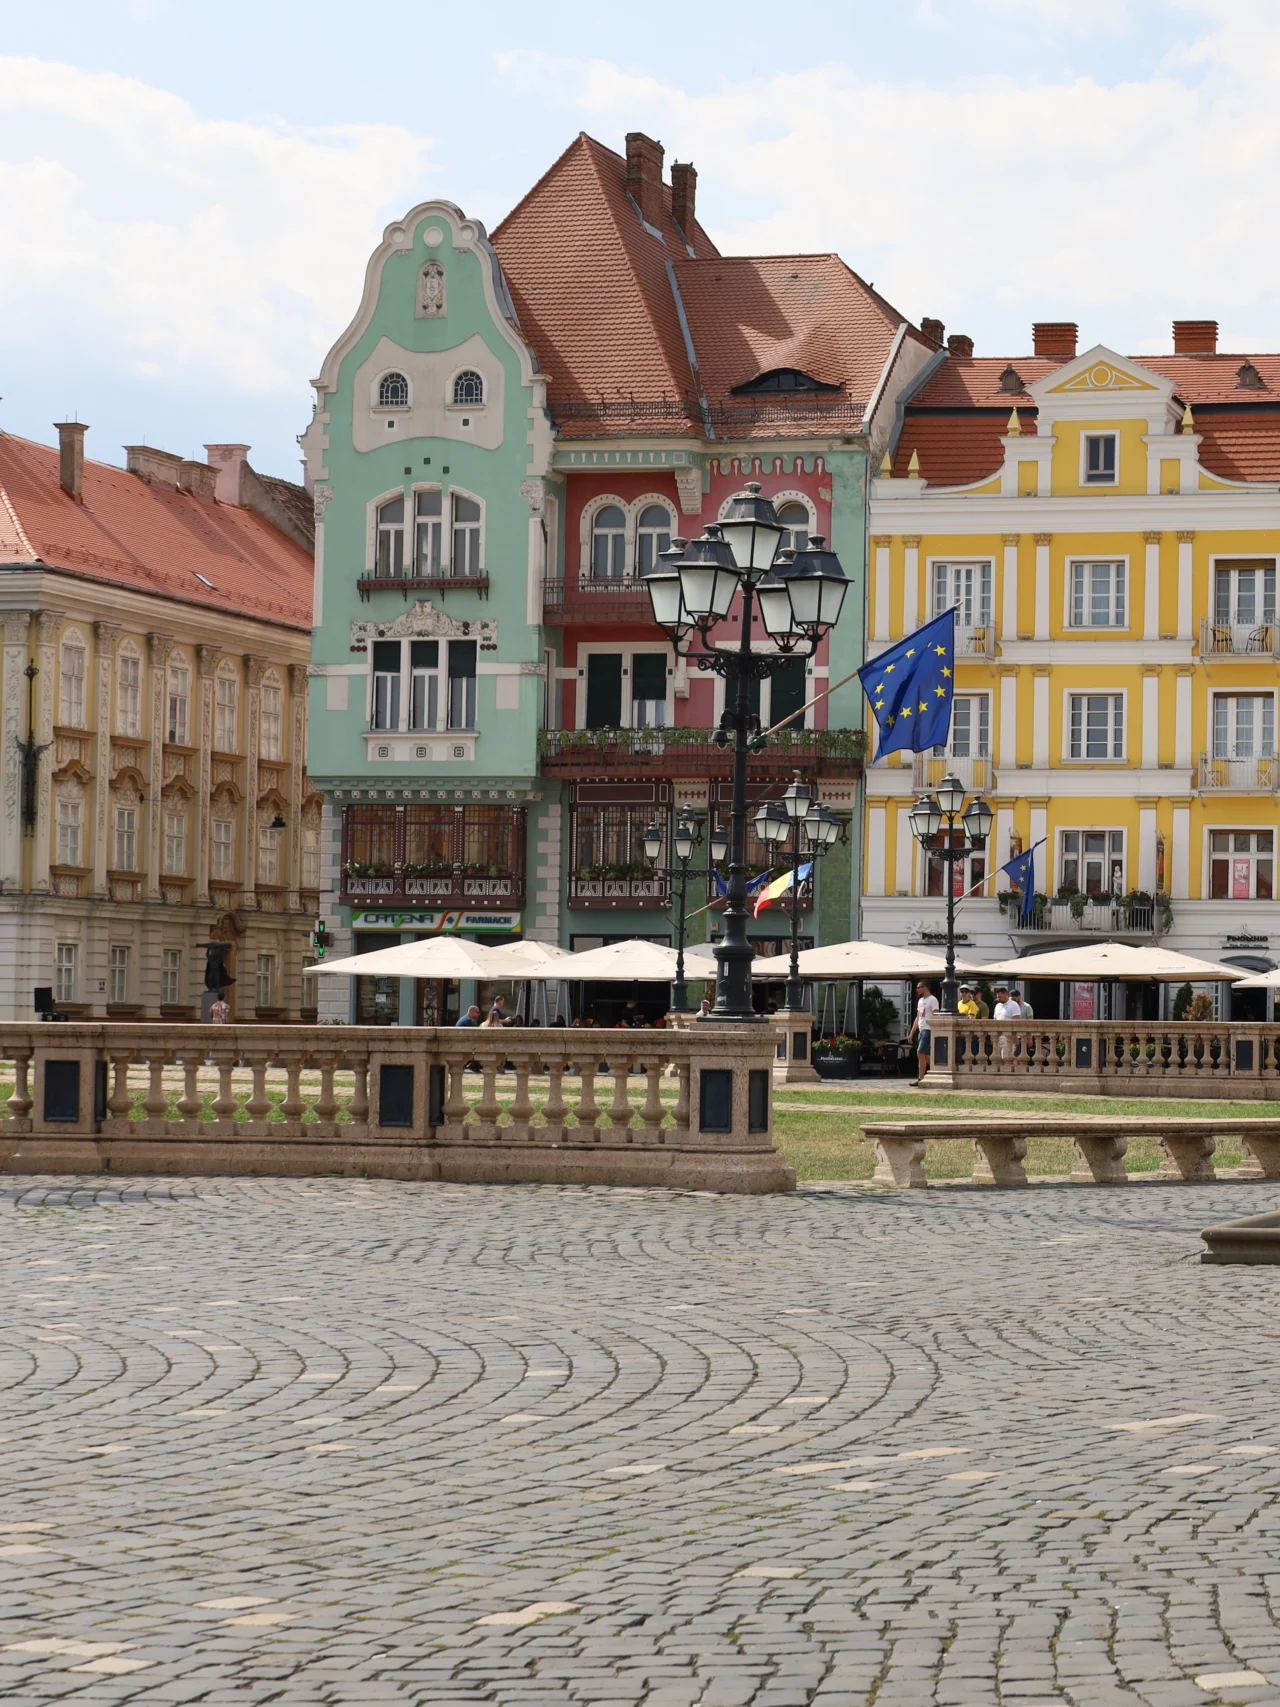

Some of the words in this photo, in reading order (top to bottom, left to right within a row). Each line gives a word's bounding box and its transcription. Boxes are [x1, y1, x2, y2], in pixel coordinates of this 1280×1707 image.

[364, 913, 434, 924] CATENA
[465, 916, 512, 925] FARMACIE
[921, 932, 969, 940] PINOCHIO
